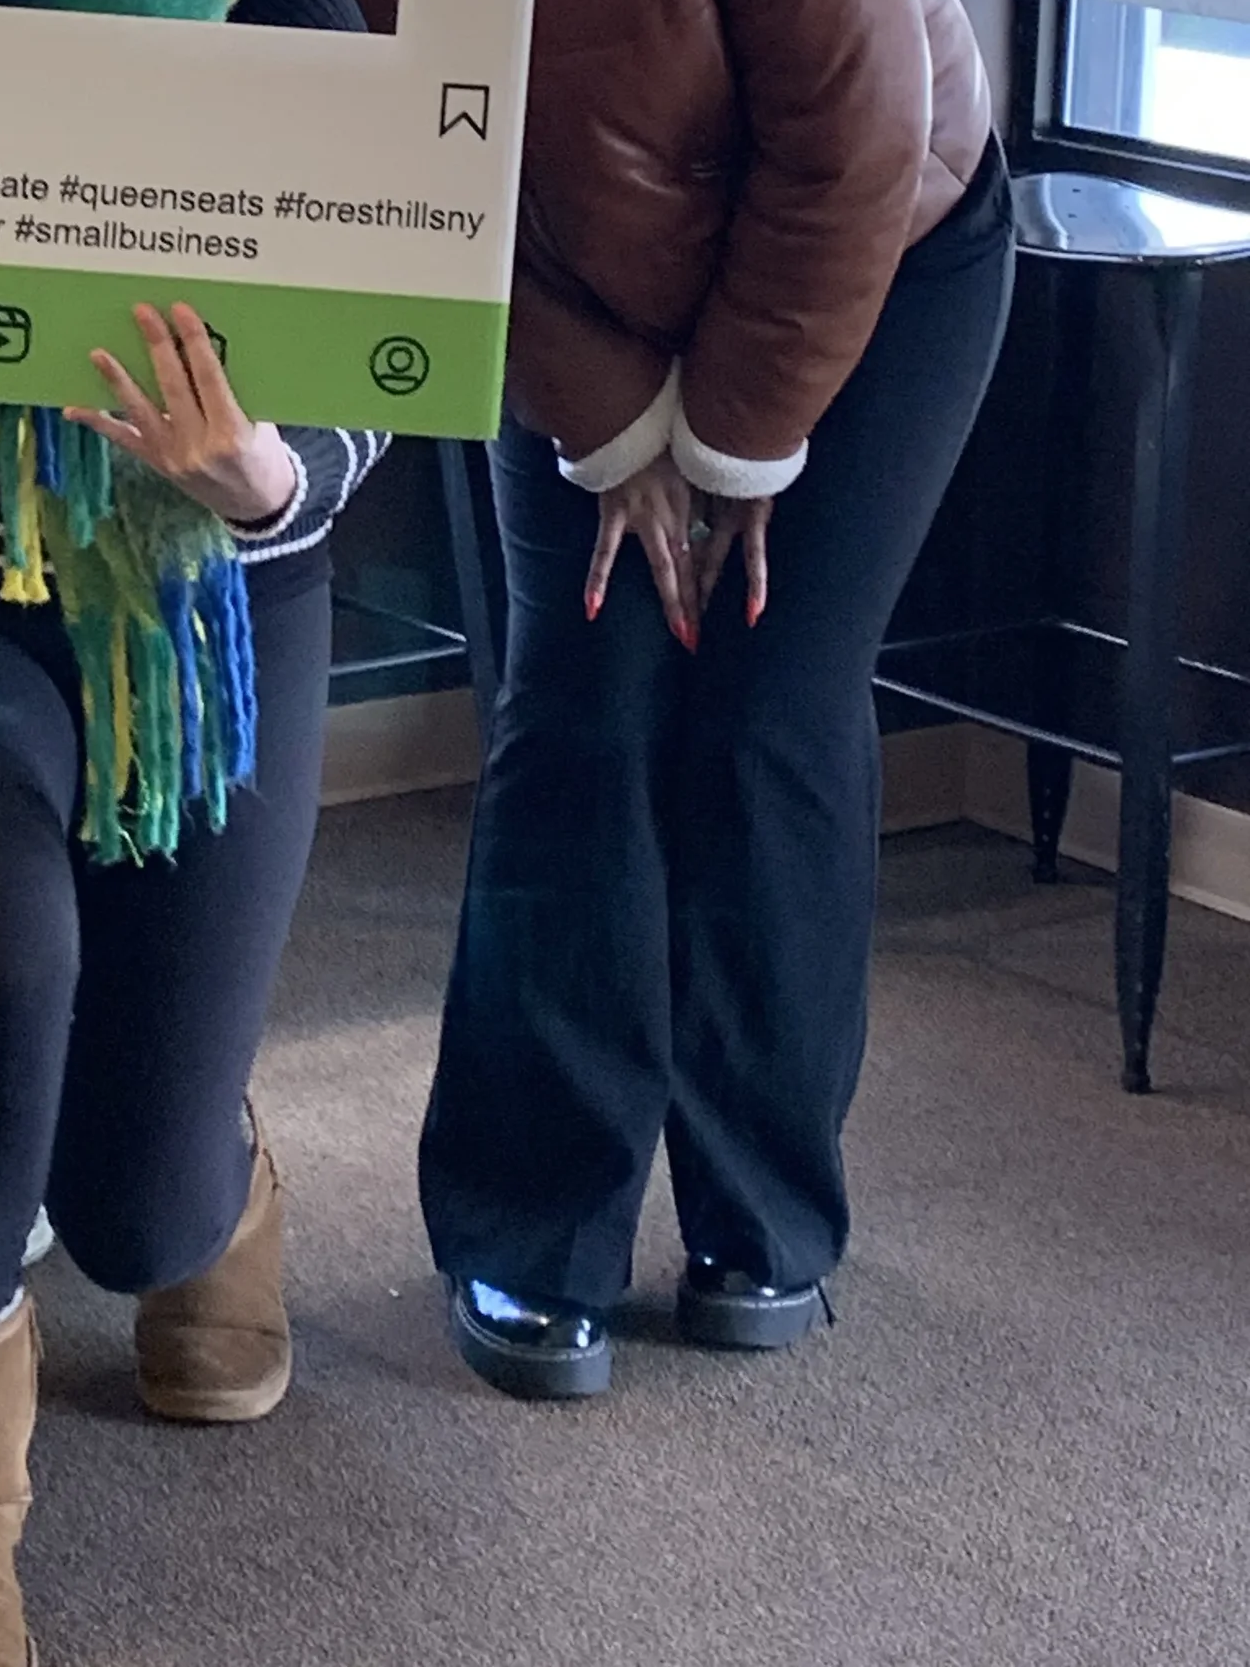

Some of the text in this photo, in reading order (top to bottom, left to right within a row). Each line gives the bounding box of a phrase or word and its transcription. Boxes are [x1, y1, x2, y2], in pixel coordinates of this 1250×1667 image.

[59, 174, 264, 218] #queenseats
[274, 190, 486, 240] #foresthillsny
[14, 213, 259, 260] #smallbusiness
